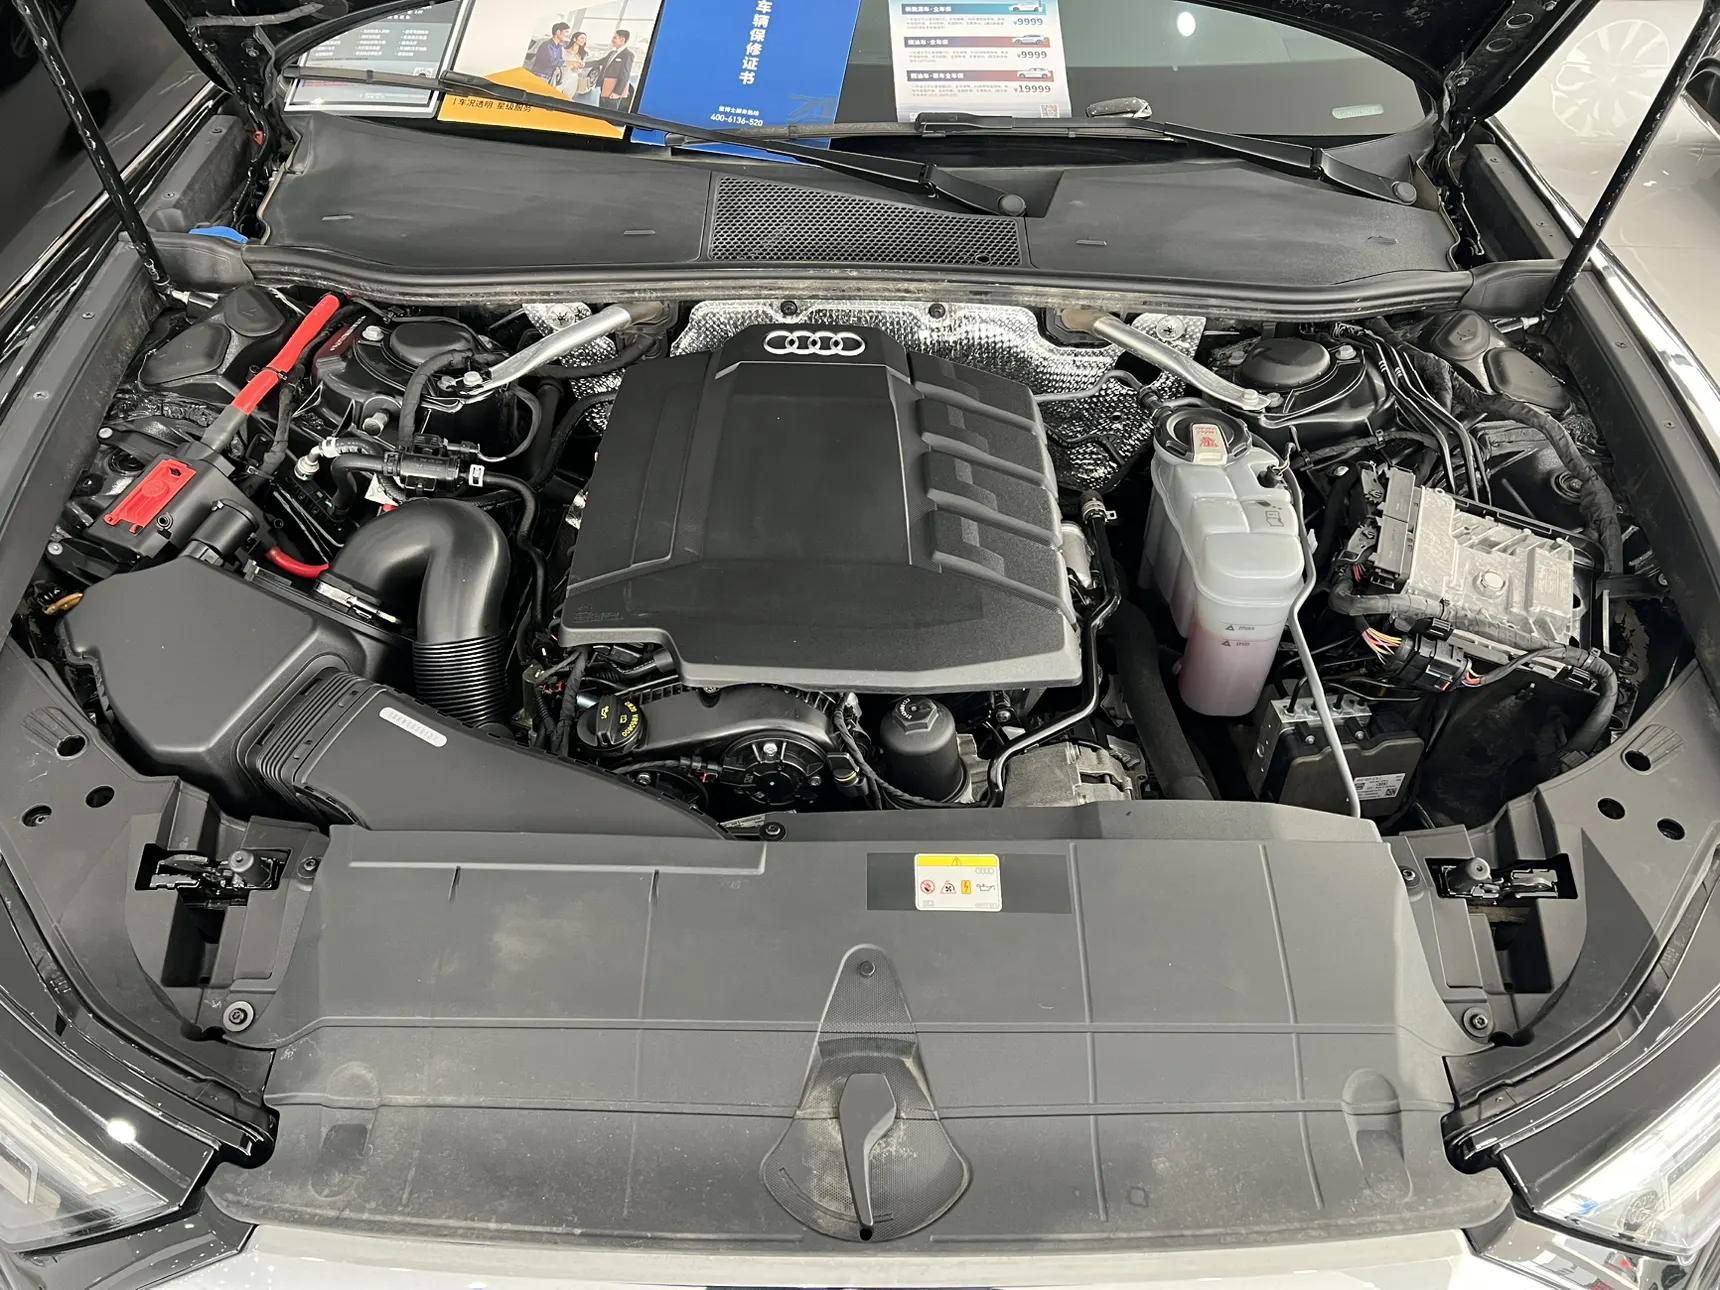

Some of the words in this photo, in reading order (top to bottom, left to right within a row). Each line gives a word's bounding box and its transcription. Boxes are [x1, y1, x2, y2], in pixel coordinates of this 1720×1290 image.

[1013, 18, 1043, 26] ¥9999
[738, 0, 773, 85] 车辆保修证书
[1017, 51, 1047, 59] ¥9999
[1013, 85, 1051, 93] ¥19999
[458, 98, 494, 109] 车况透明
[710, 113, 763, 127] 400-6136-520
